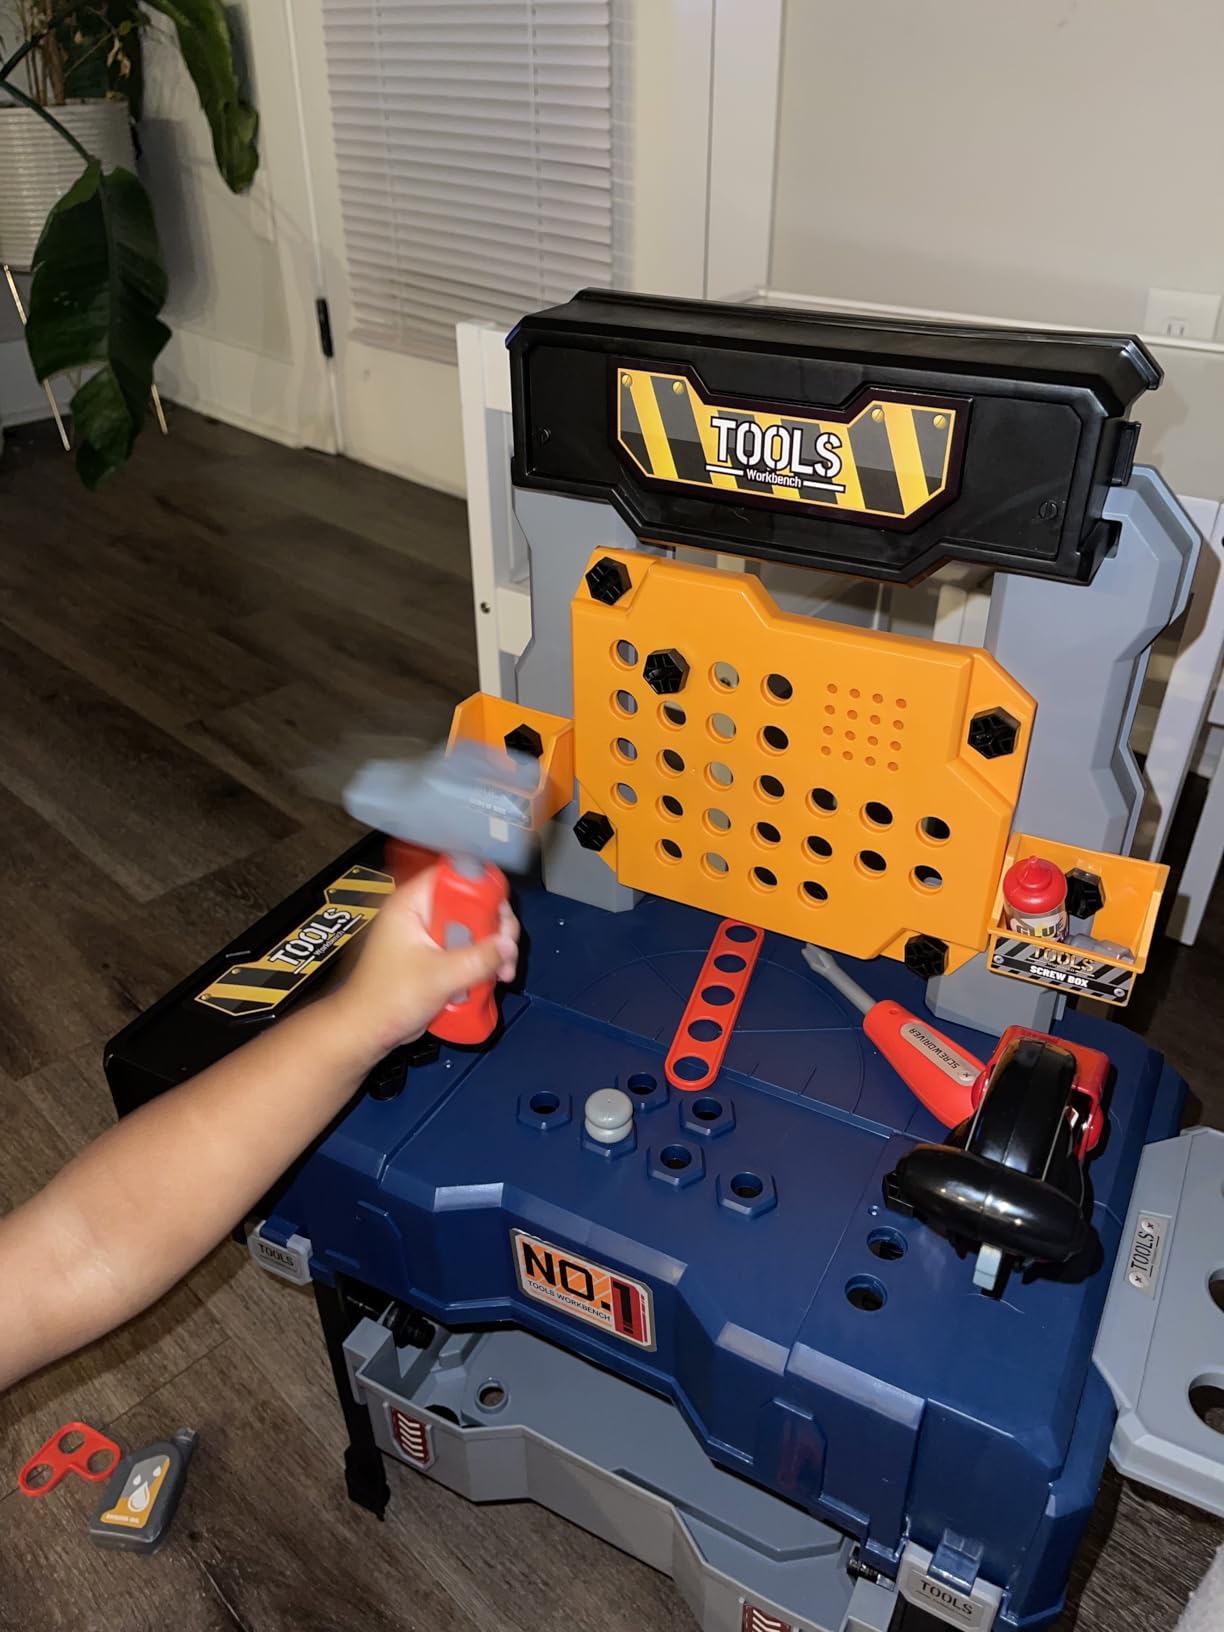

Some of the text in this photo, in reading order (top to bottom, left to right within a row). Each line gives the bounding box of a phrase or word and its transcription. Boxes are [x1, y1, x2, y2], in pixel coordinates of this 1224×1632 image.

[709, 417, 843, 478] TOOLS
[746, 467, 802, 488] Workbench
[268, 907, 352, 966] TOOLS
[1029, 965, 1067, 982] SCREW
[1067, 975, 1089, 988] BOX
[1033, 944, 1096, 973] TOOLS
[908, 1027, 961, 1070] SCREWDRIVER
[258, 1243, 294, 1267] TOOLS
[1130, 1231, 1155, 1272] TOOLS
[527, 1280, 611, 1322] TOOLS WORKBENCH
[919, 1579, 974, 1616] TOOLS
